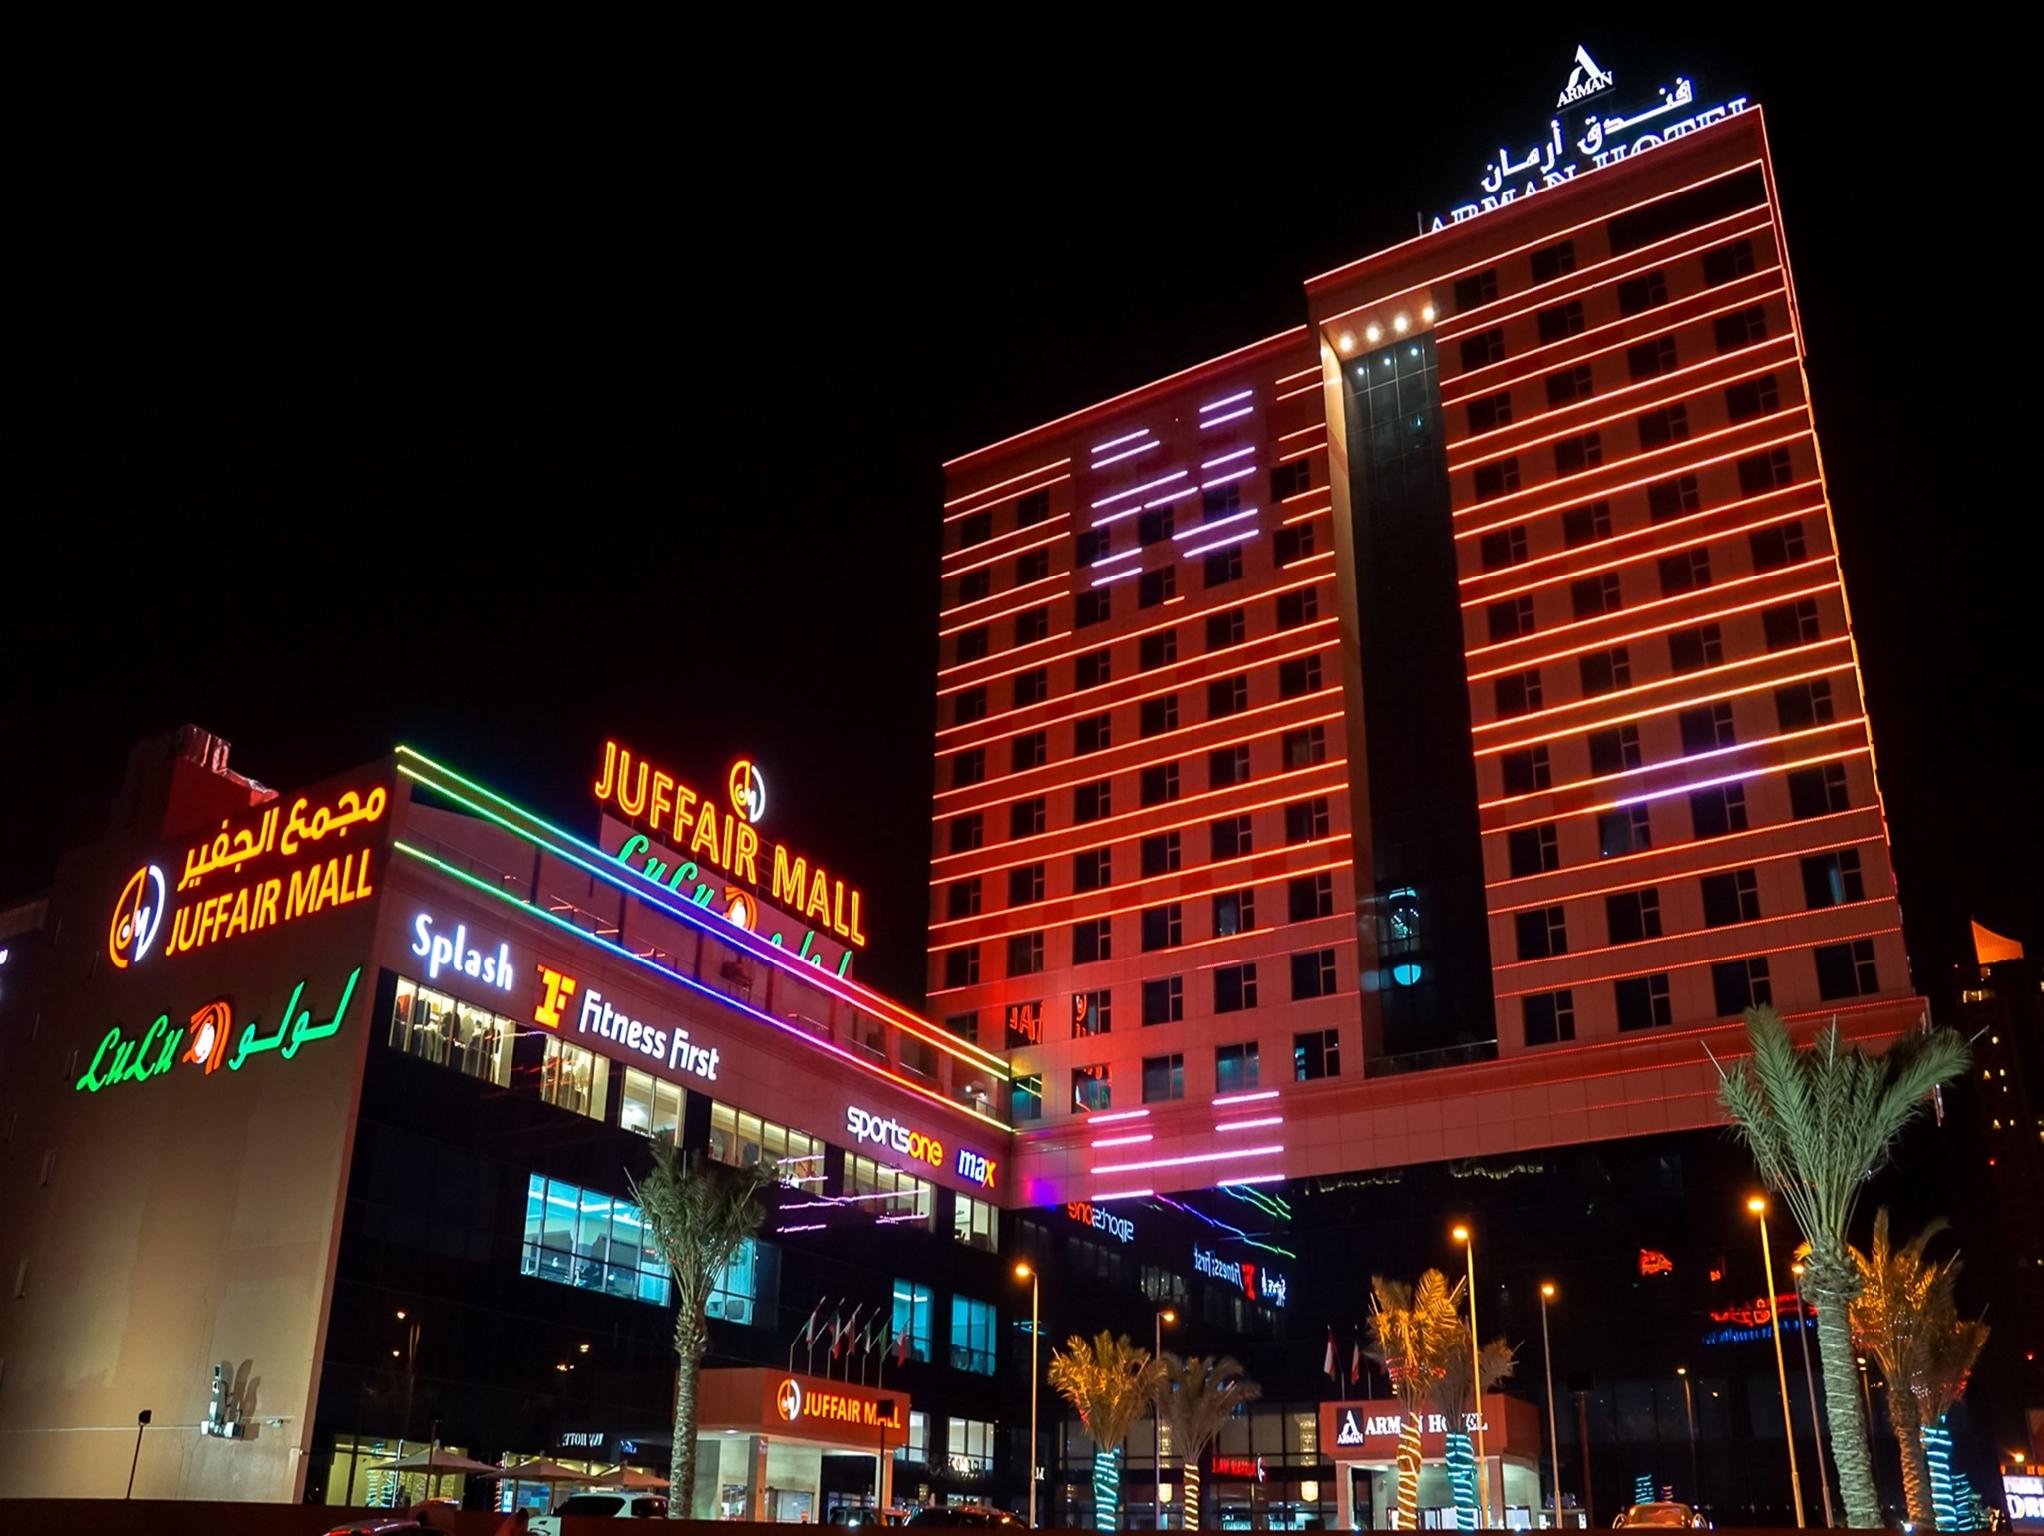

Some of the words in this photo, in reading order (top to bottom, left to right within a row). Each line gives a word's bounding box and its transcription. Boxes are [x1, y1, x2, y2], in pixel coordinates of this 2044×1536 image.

[1556, 71, 1614, 108] ARMAN
[1577, 78, 1692, 154] فندق
[177, 806, 280, 891] الجفير
[281, 787, 387, 855] مجمع
[595, 741, 758, 885] JUFFAIR
[772, 845, 865, 946] MALL
[165, 878, 281, 956] JUFFAIR
[285, 849, 373, 920] MALL
[412, 912, 514, 992] Splash
[76, 1014, 184, 1092] LuLu
[228, 967, 361, 1070] لولو
[579, 989, 668, 1060] Fitness
[668, 1027, 721, 1080] First
[958, 1149, 997, 1188] max
[804, 1391, 861, 1424] JUFFAIR
[1365, 1413, 1423, 1436] ARM
